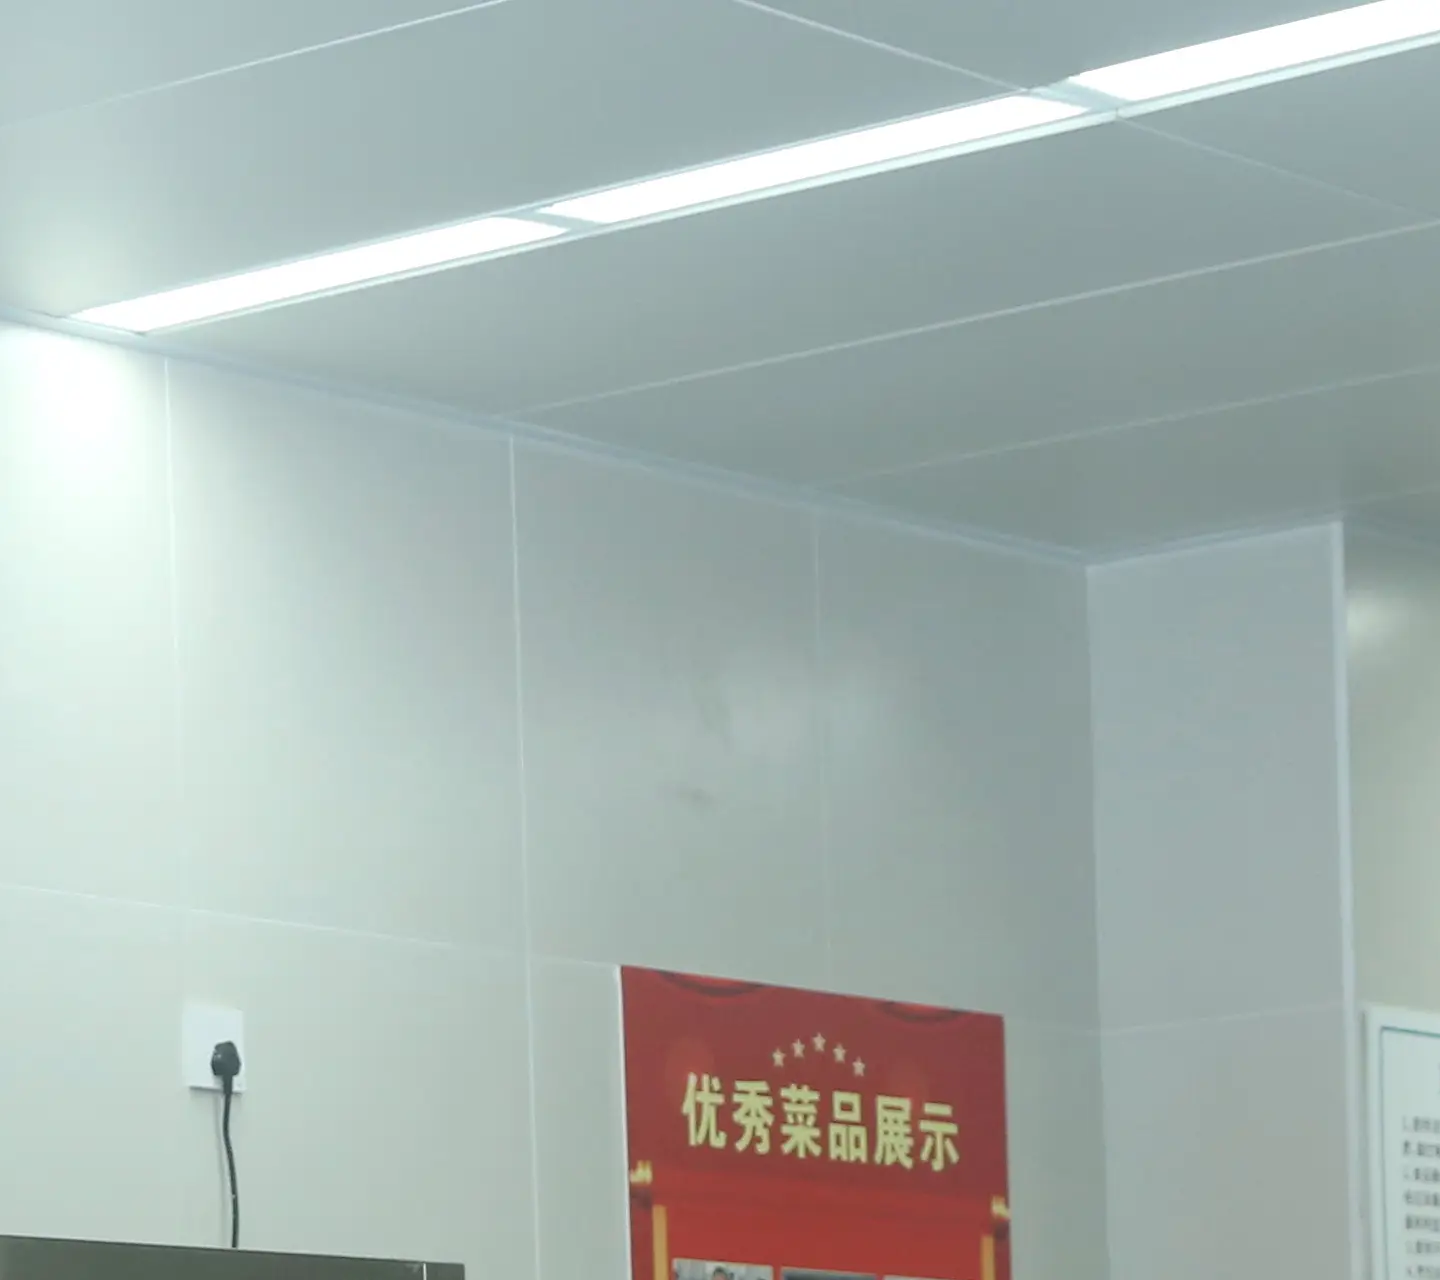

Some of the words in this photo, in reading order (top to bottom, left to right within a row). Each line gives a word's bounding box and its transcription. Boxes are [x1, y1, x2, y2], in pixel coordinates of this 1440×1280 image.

[681, 1072, 960, 1171] 优秀菜品展示
